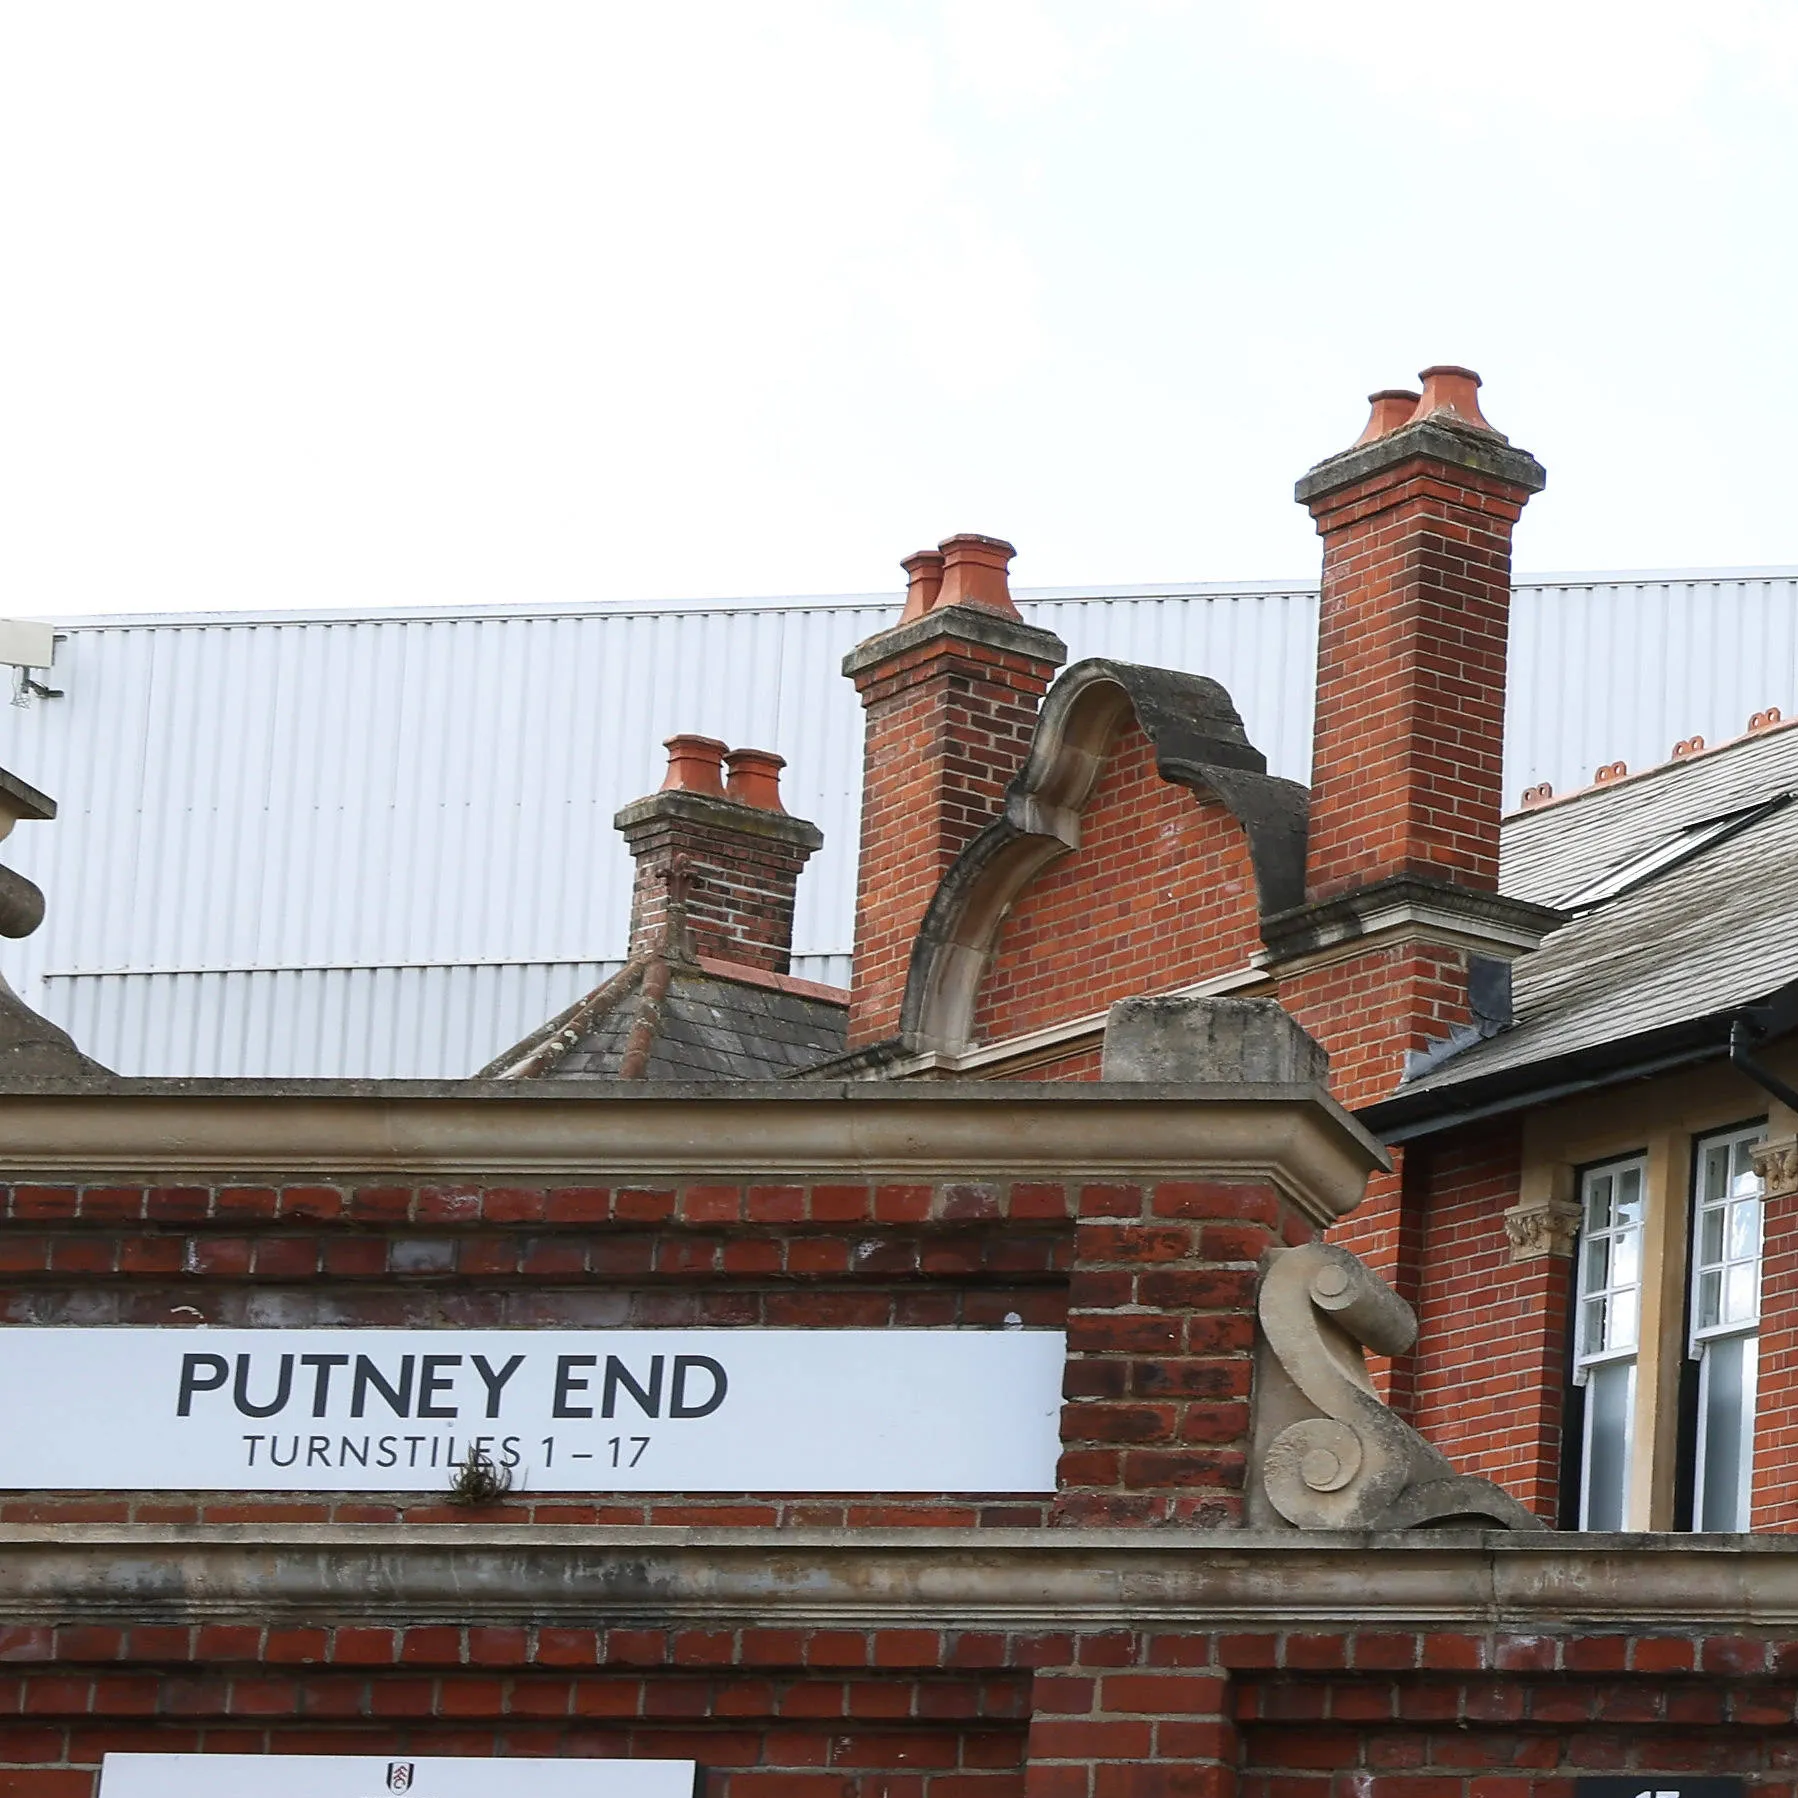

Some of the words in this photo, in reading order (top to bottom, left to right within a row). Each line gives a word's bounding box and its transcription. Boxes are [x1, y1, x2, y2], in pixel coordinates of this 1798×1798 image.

[177, 1353, 526, 1419] PUTNEY
[552, 1355, 728, 1419] END
[244, 1435, 521, 1469] TURNSTILES
[542, 1436, 553, 1468] 1
[608, 1436, 651, 1468] 17
